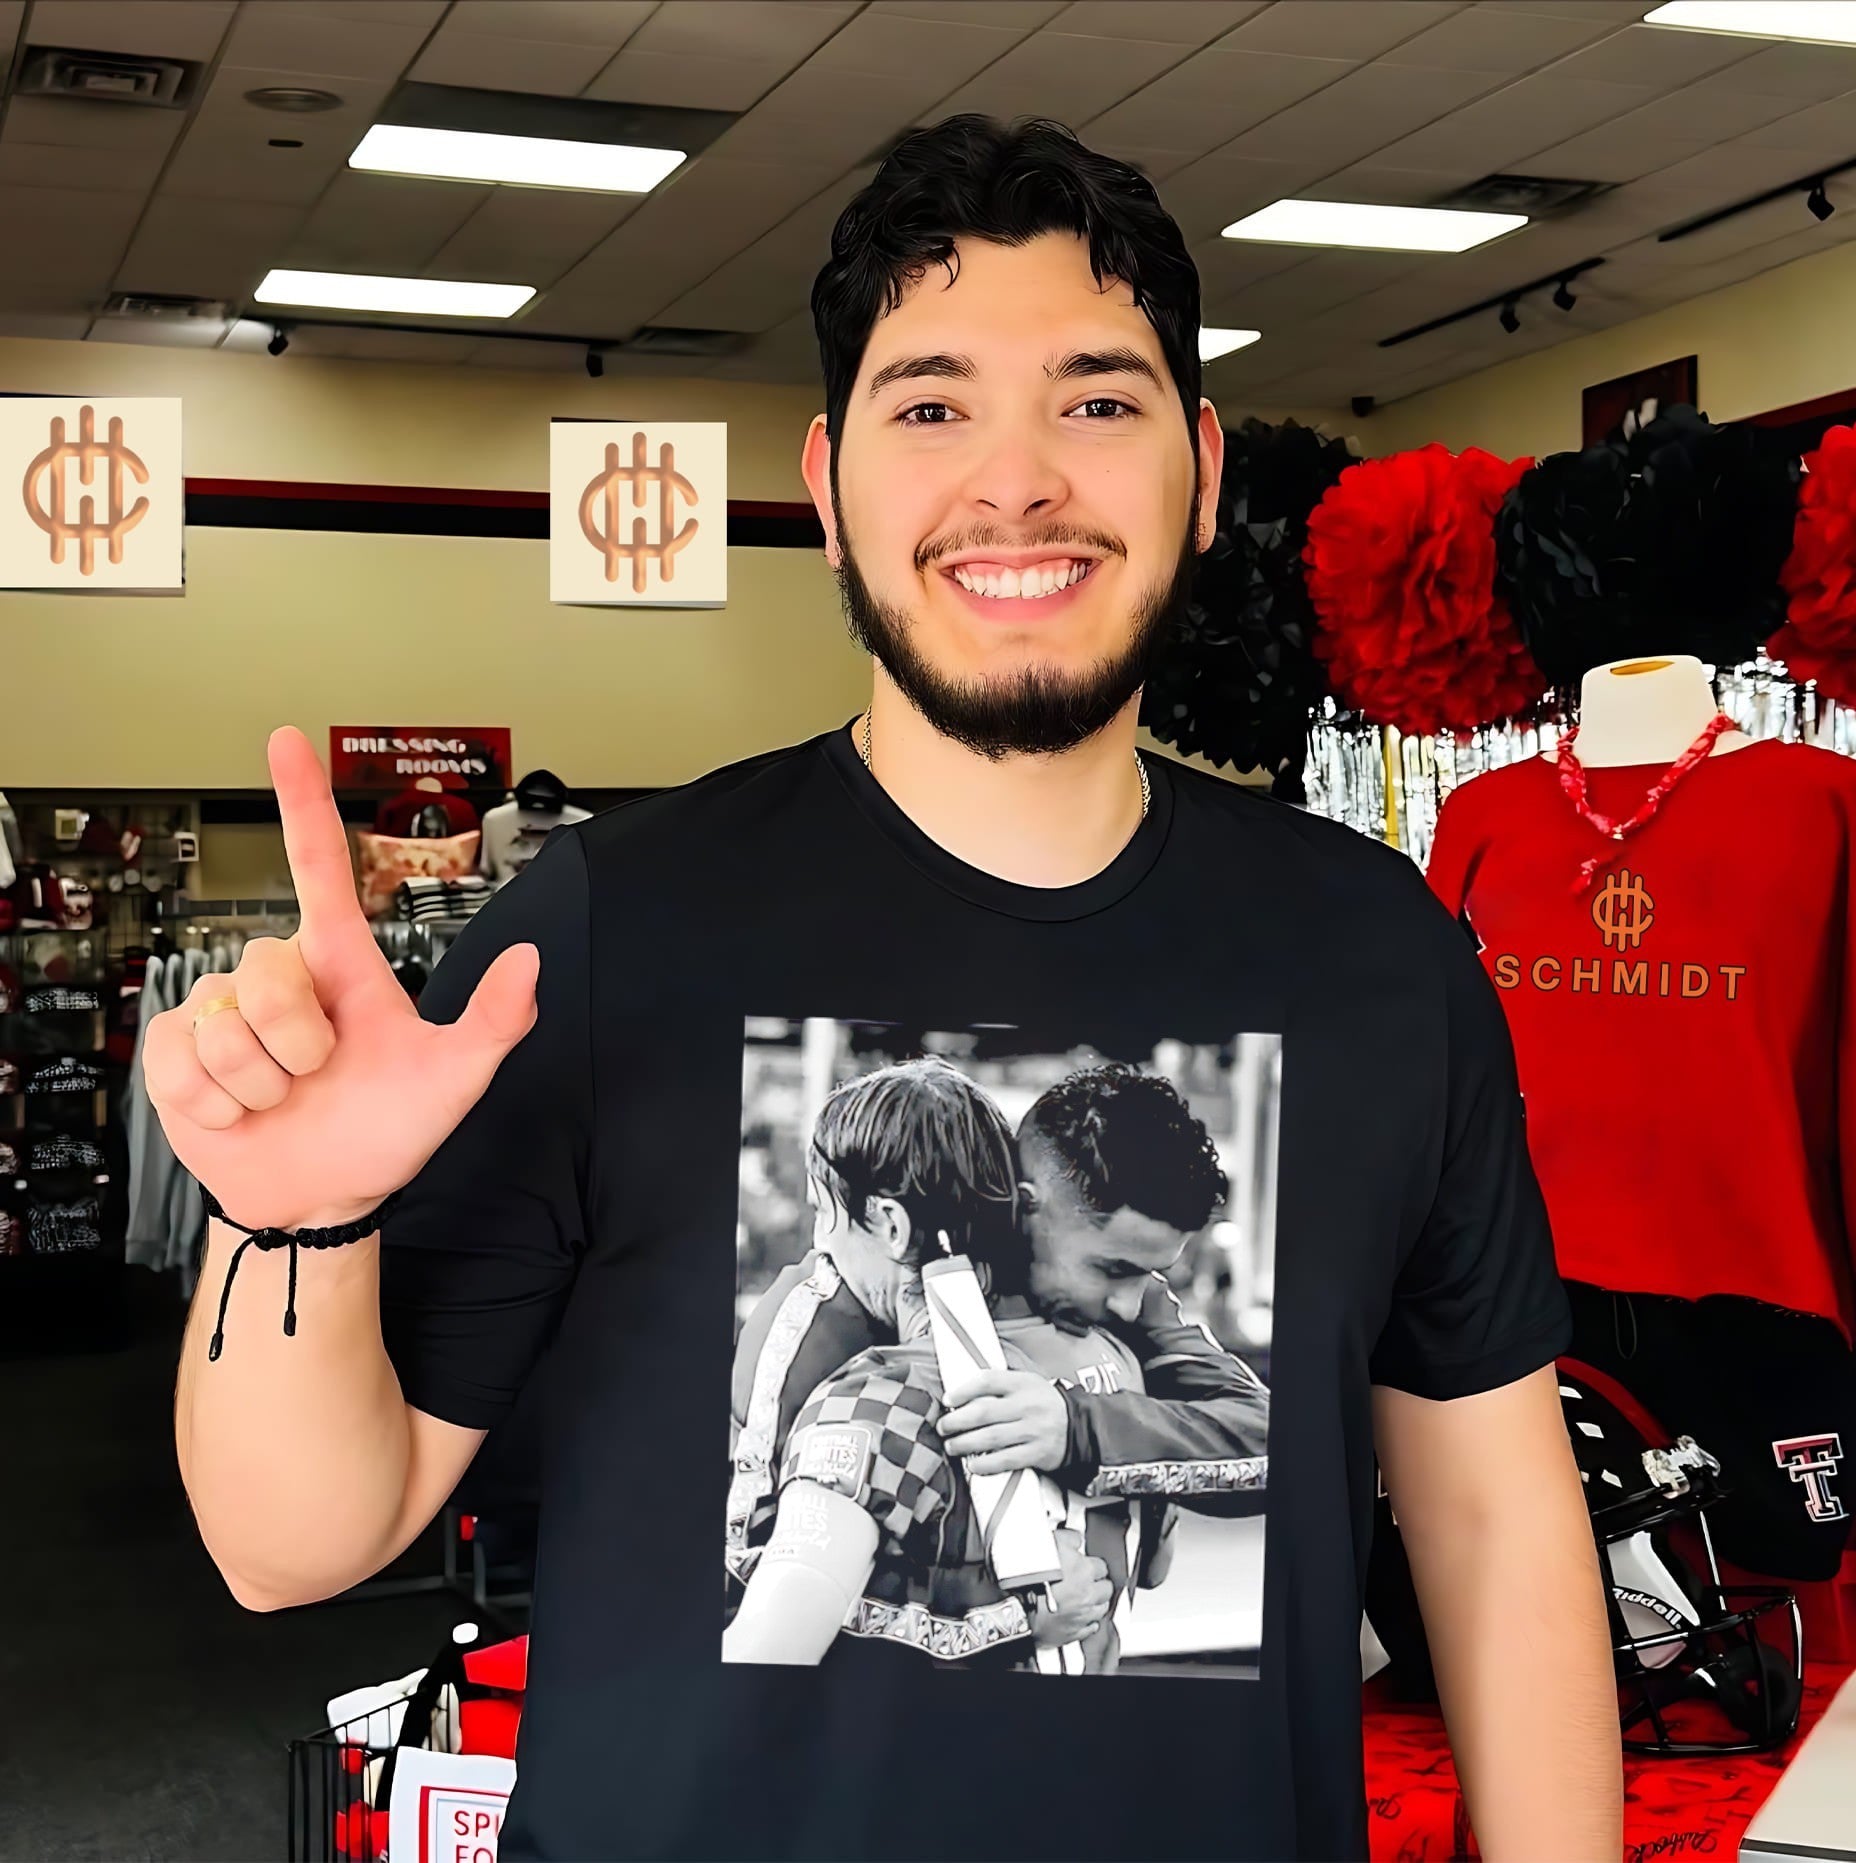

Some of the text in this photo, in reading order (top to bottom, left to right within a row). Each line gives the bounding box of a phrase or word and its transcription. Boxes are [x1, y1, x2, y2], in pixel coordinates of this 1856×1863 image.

[342, 736, 466, 754] DRESSING
[396, 758, 487, 775] ROOMS
[1494, 954, 1746, 1000] SCHMIDT
[1612, 1586, 1683, 1627] Riddell
